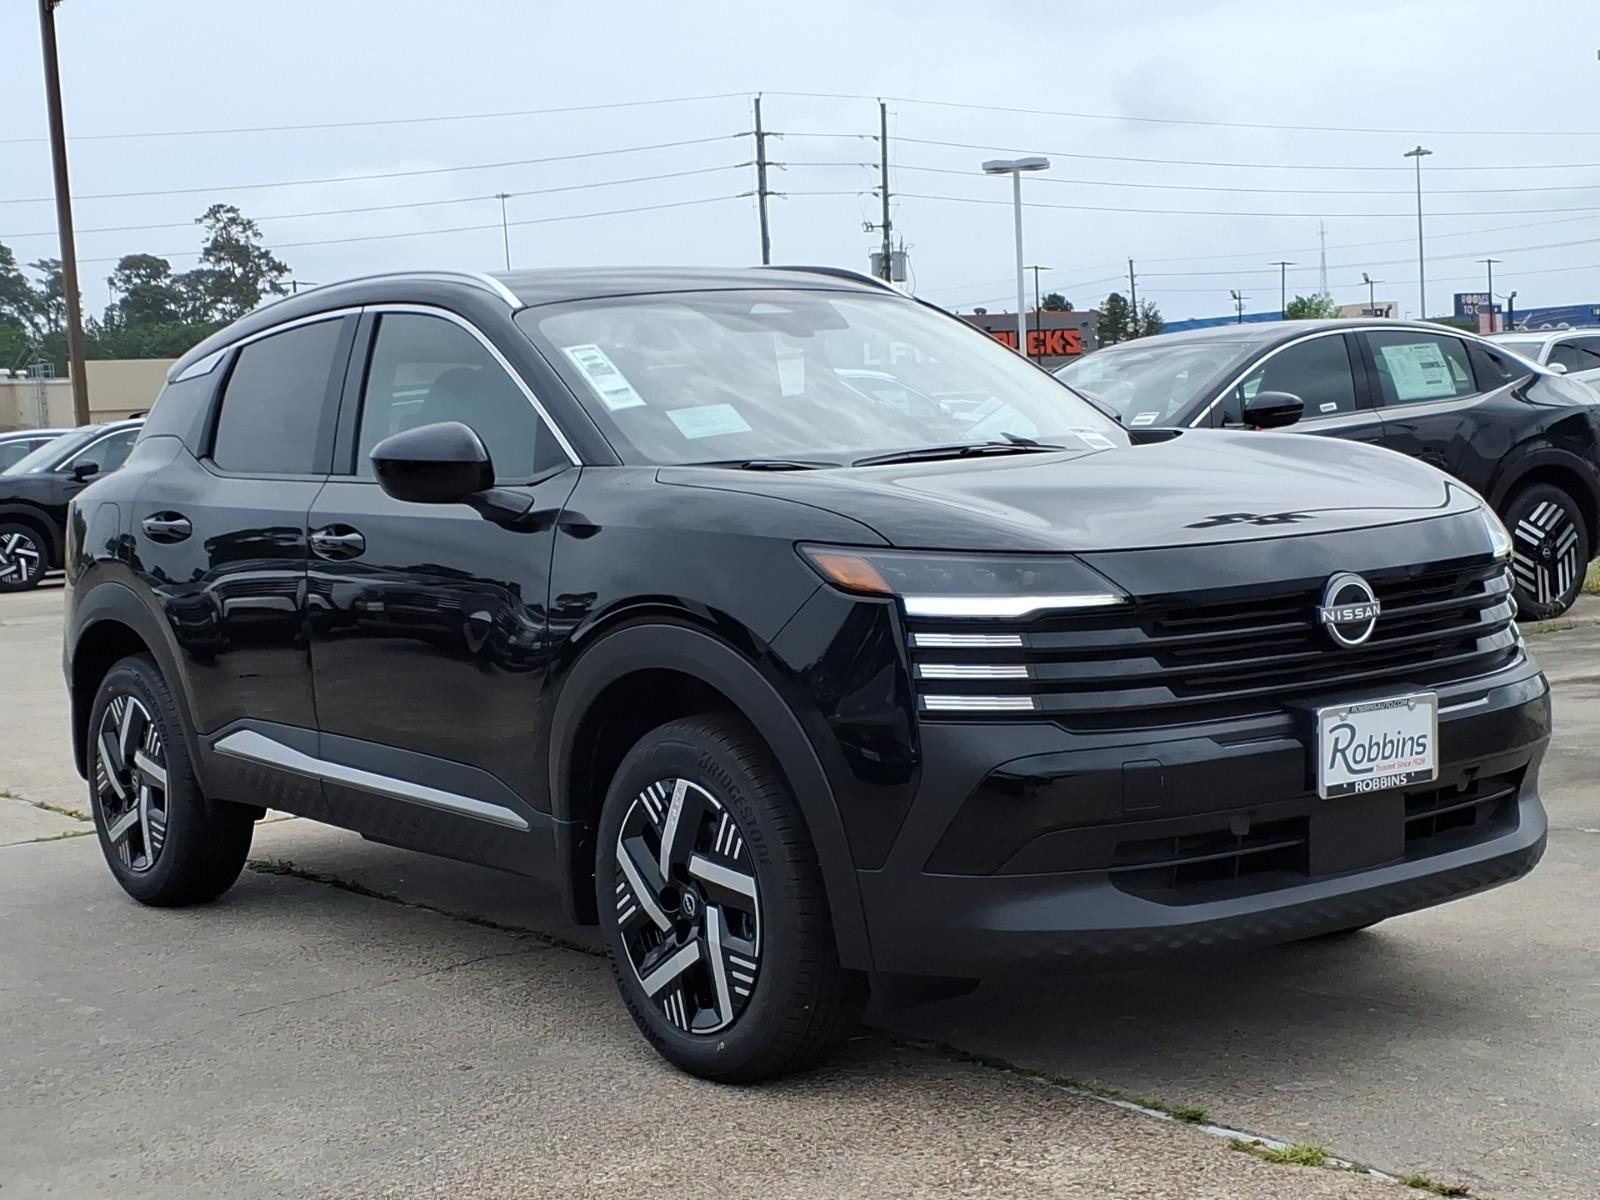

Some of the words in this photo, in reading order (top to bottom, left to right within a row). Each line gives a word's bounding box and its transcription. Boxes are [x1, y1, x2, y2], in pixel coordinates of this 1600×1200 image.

[1461, 294, 1489, 304] ROOMS
[1322, 605, 1380, 622] NISSAN
[1329, 722, 1427, 775] Robbins
[1355, 773, 1407, 793] ROBBINS
